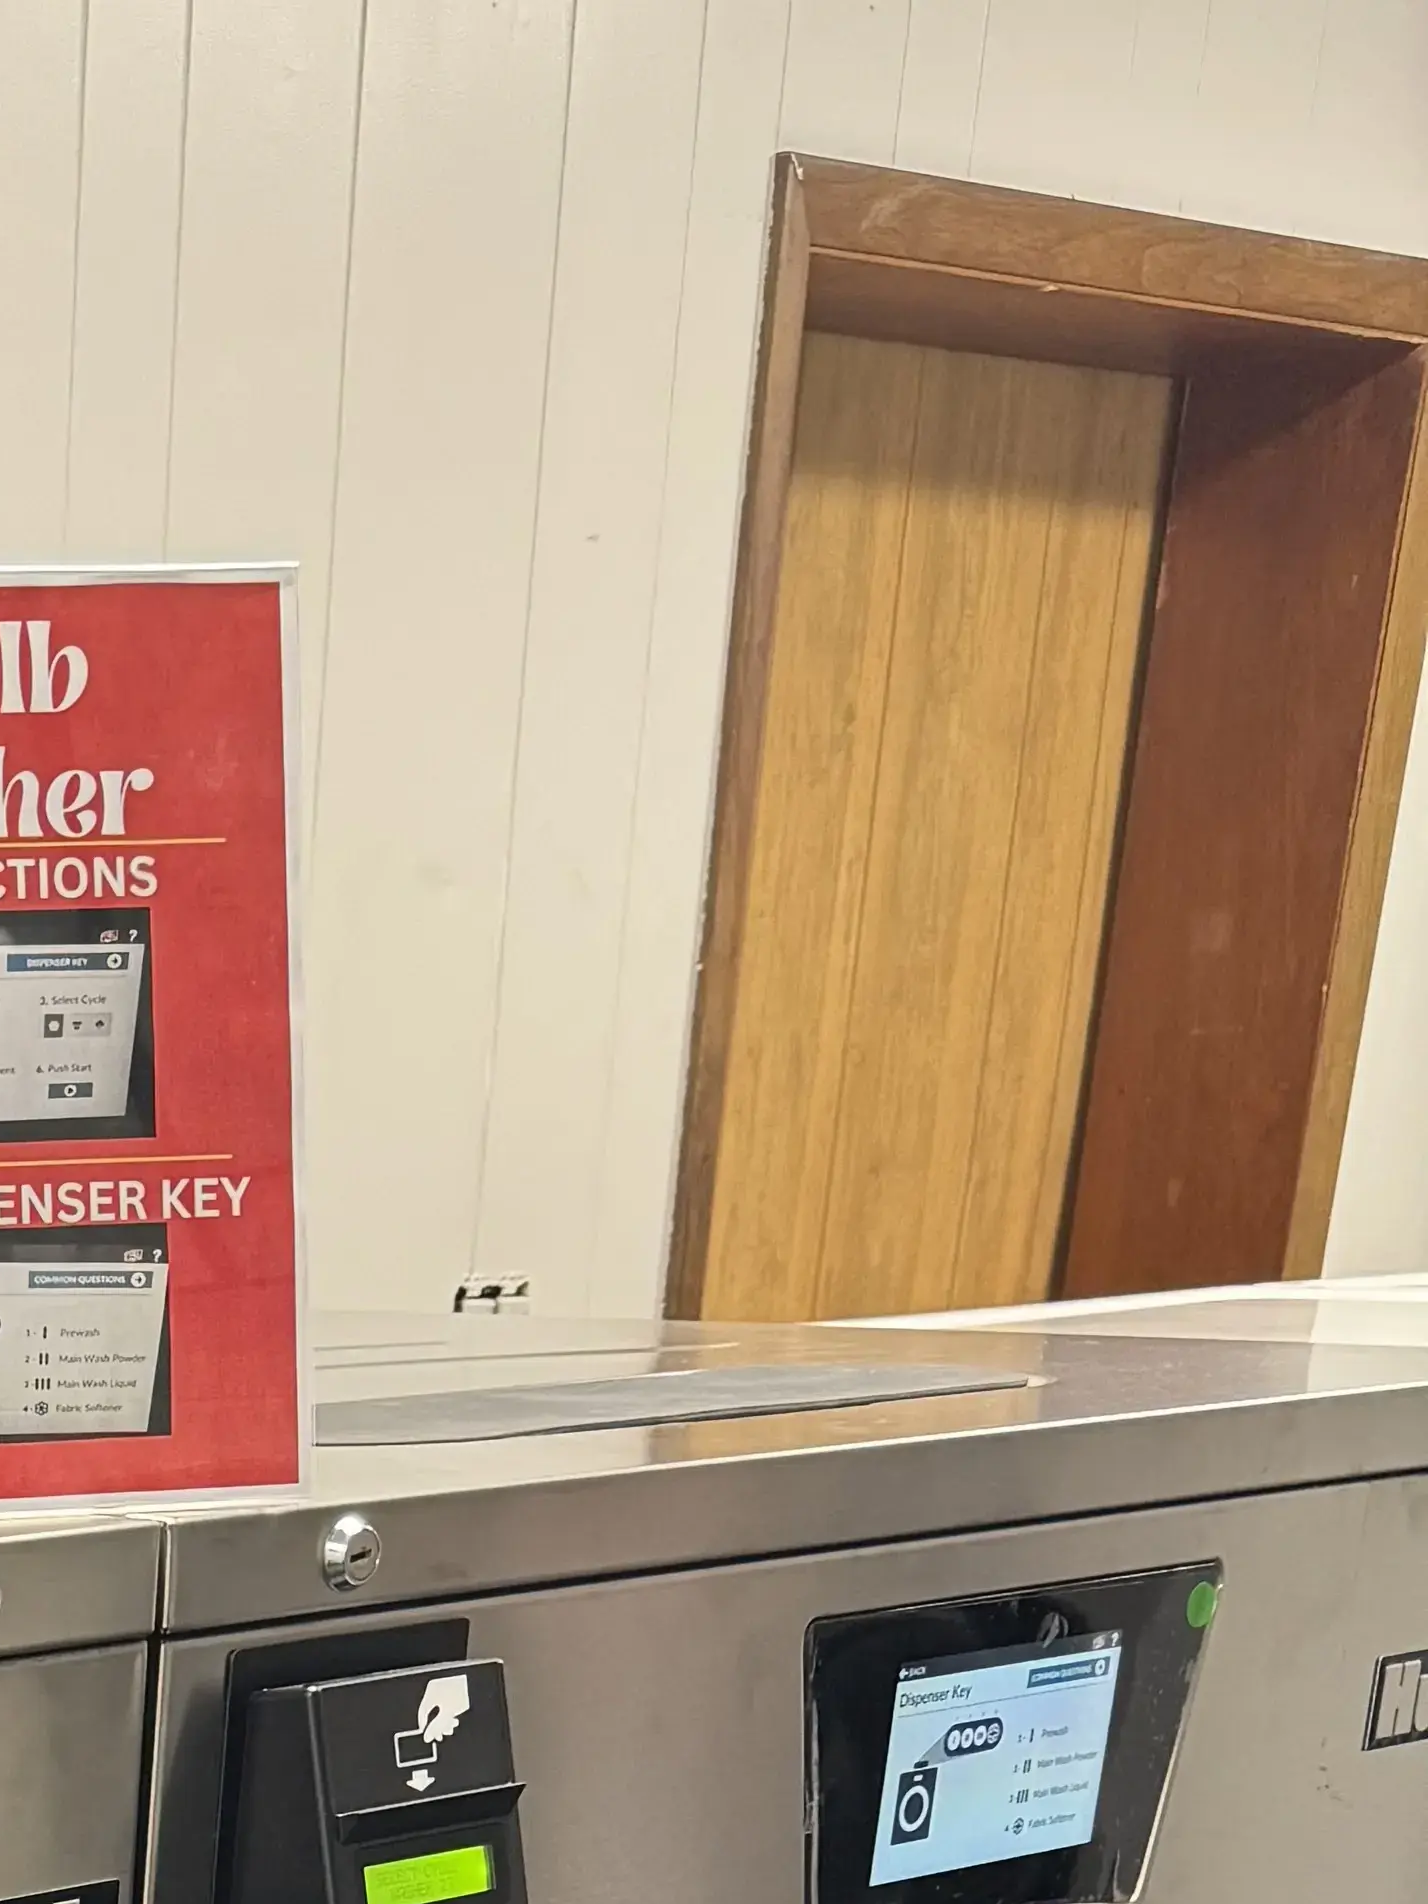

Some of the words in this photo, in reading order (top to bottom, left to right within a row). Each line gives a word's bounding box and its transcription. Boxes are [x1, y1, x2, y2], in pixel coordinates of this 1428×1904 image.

[162, 1176, 251, 1219] KEY
[34, 1275, 76, 1284] COMMON
[78, 1275, 125, 1285] QUESTIONS
[899, 1690, 950, 1708] Dispenser
[951, 1684, 973, 1700] Key
